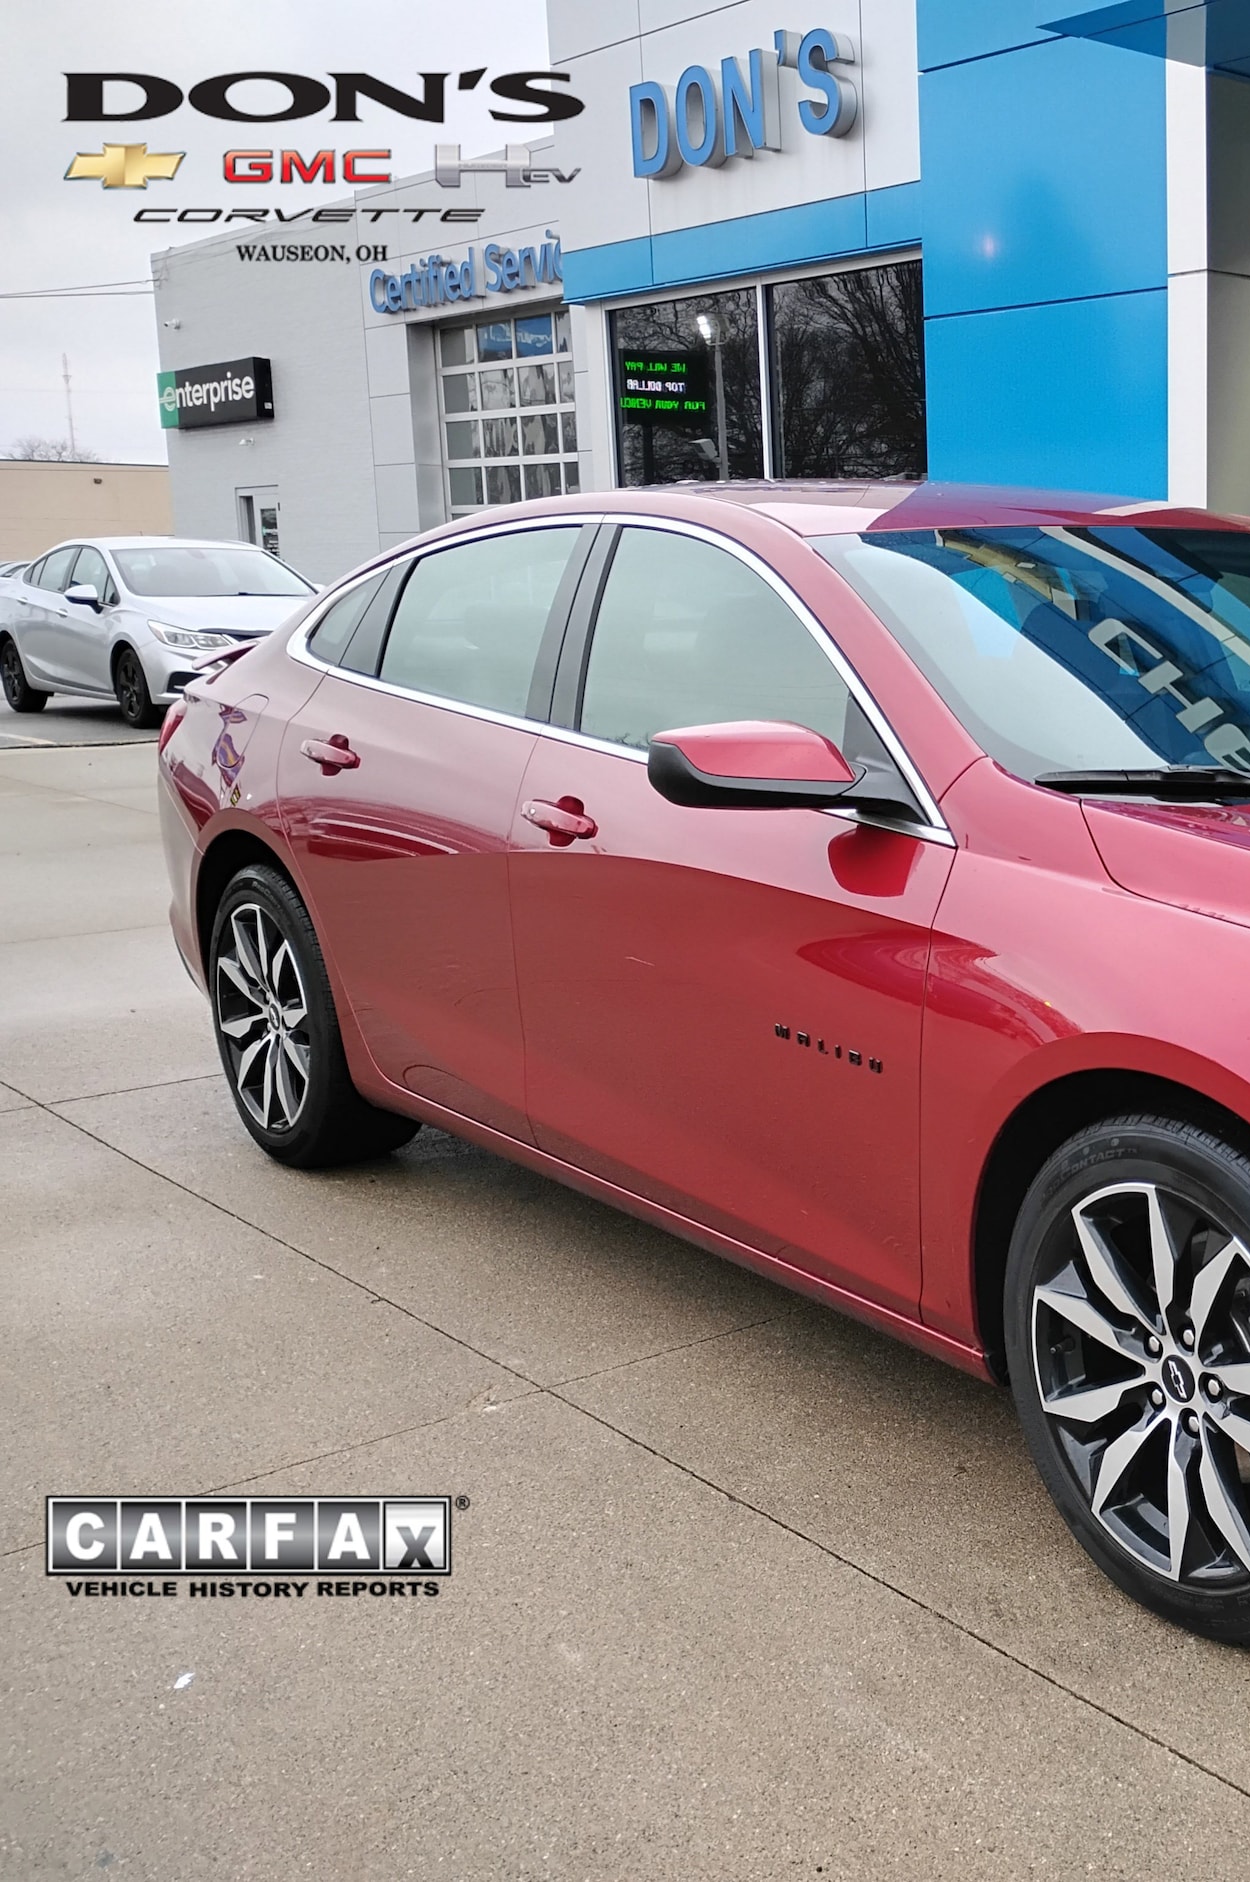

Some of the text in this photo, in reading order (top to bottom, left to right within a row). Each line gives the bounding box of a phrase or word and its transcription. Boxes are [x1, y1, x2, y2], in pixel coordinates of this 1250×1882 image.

[628, 28, 856, 178] DON'S
[370, 246, 475, 313] Certified
[160, 371, 255, 412] enterprise
[774, 1023, 884, 1074] MALIBU
